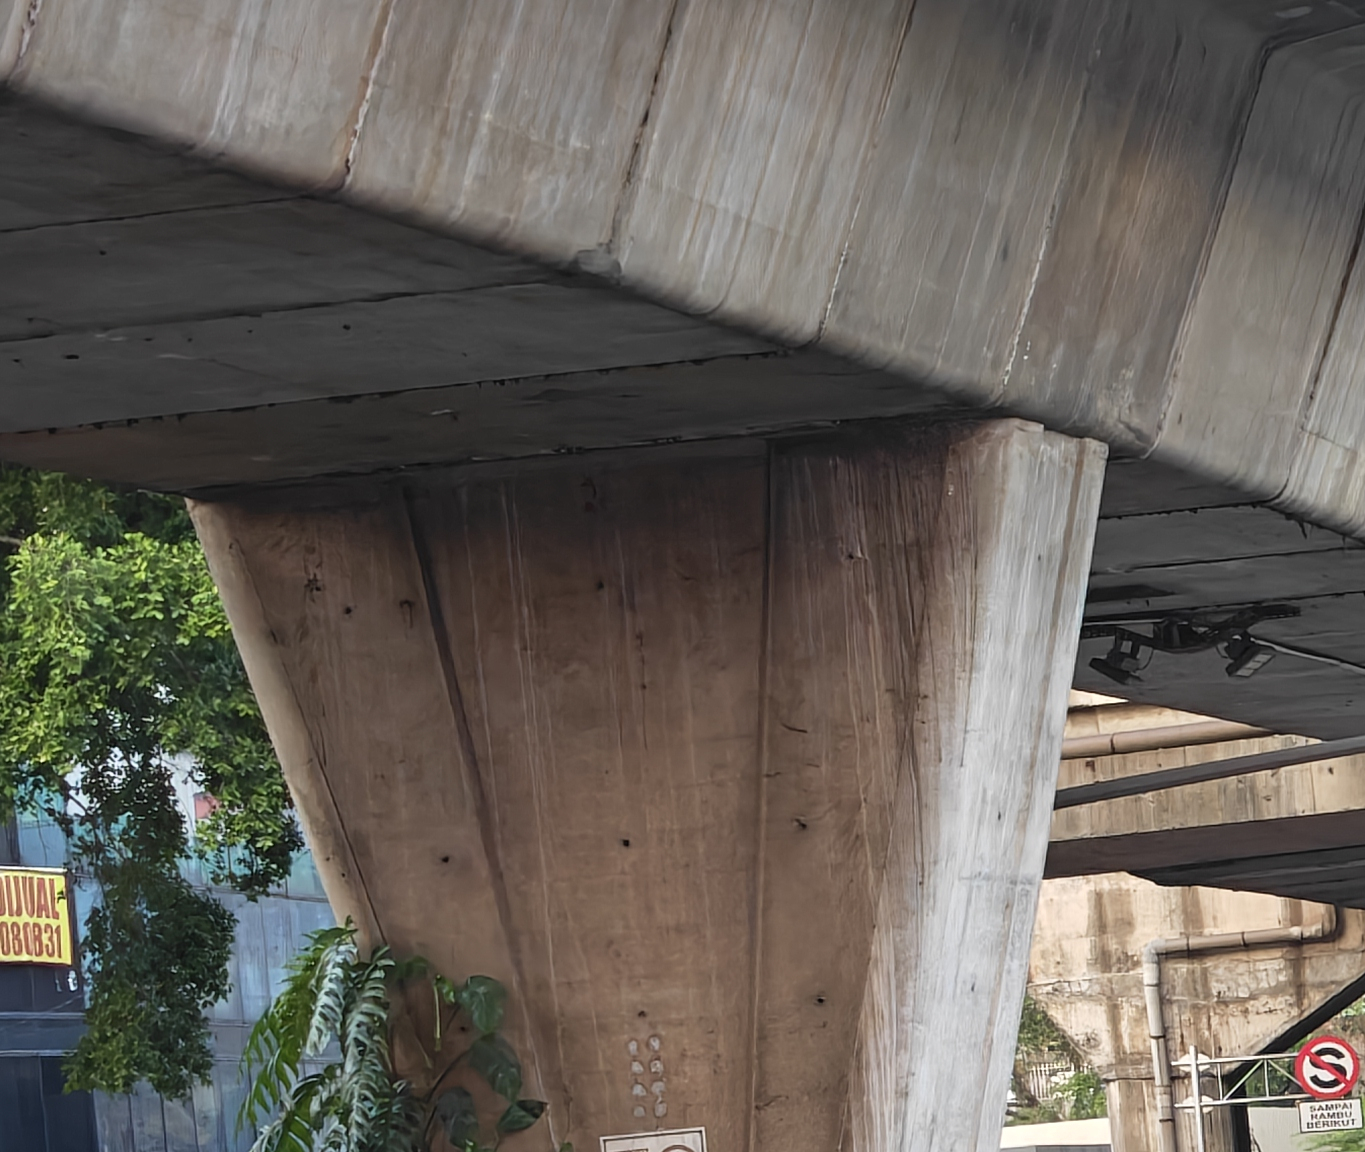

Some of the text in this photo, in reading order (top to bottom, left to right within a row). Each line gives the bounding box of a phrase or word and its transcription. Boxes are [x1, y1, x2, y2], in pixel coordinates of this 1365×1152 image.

[1310, 1102, 1352, 1112] SAMPAI
[1311, 1111, 1352, 1121] RAMBU
[1306, 1118, 1356, 1129] BERIKUT
